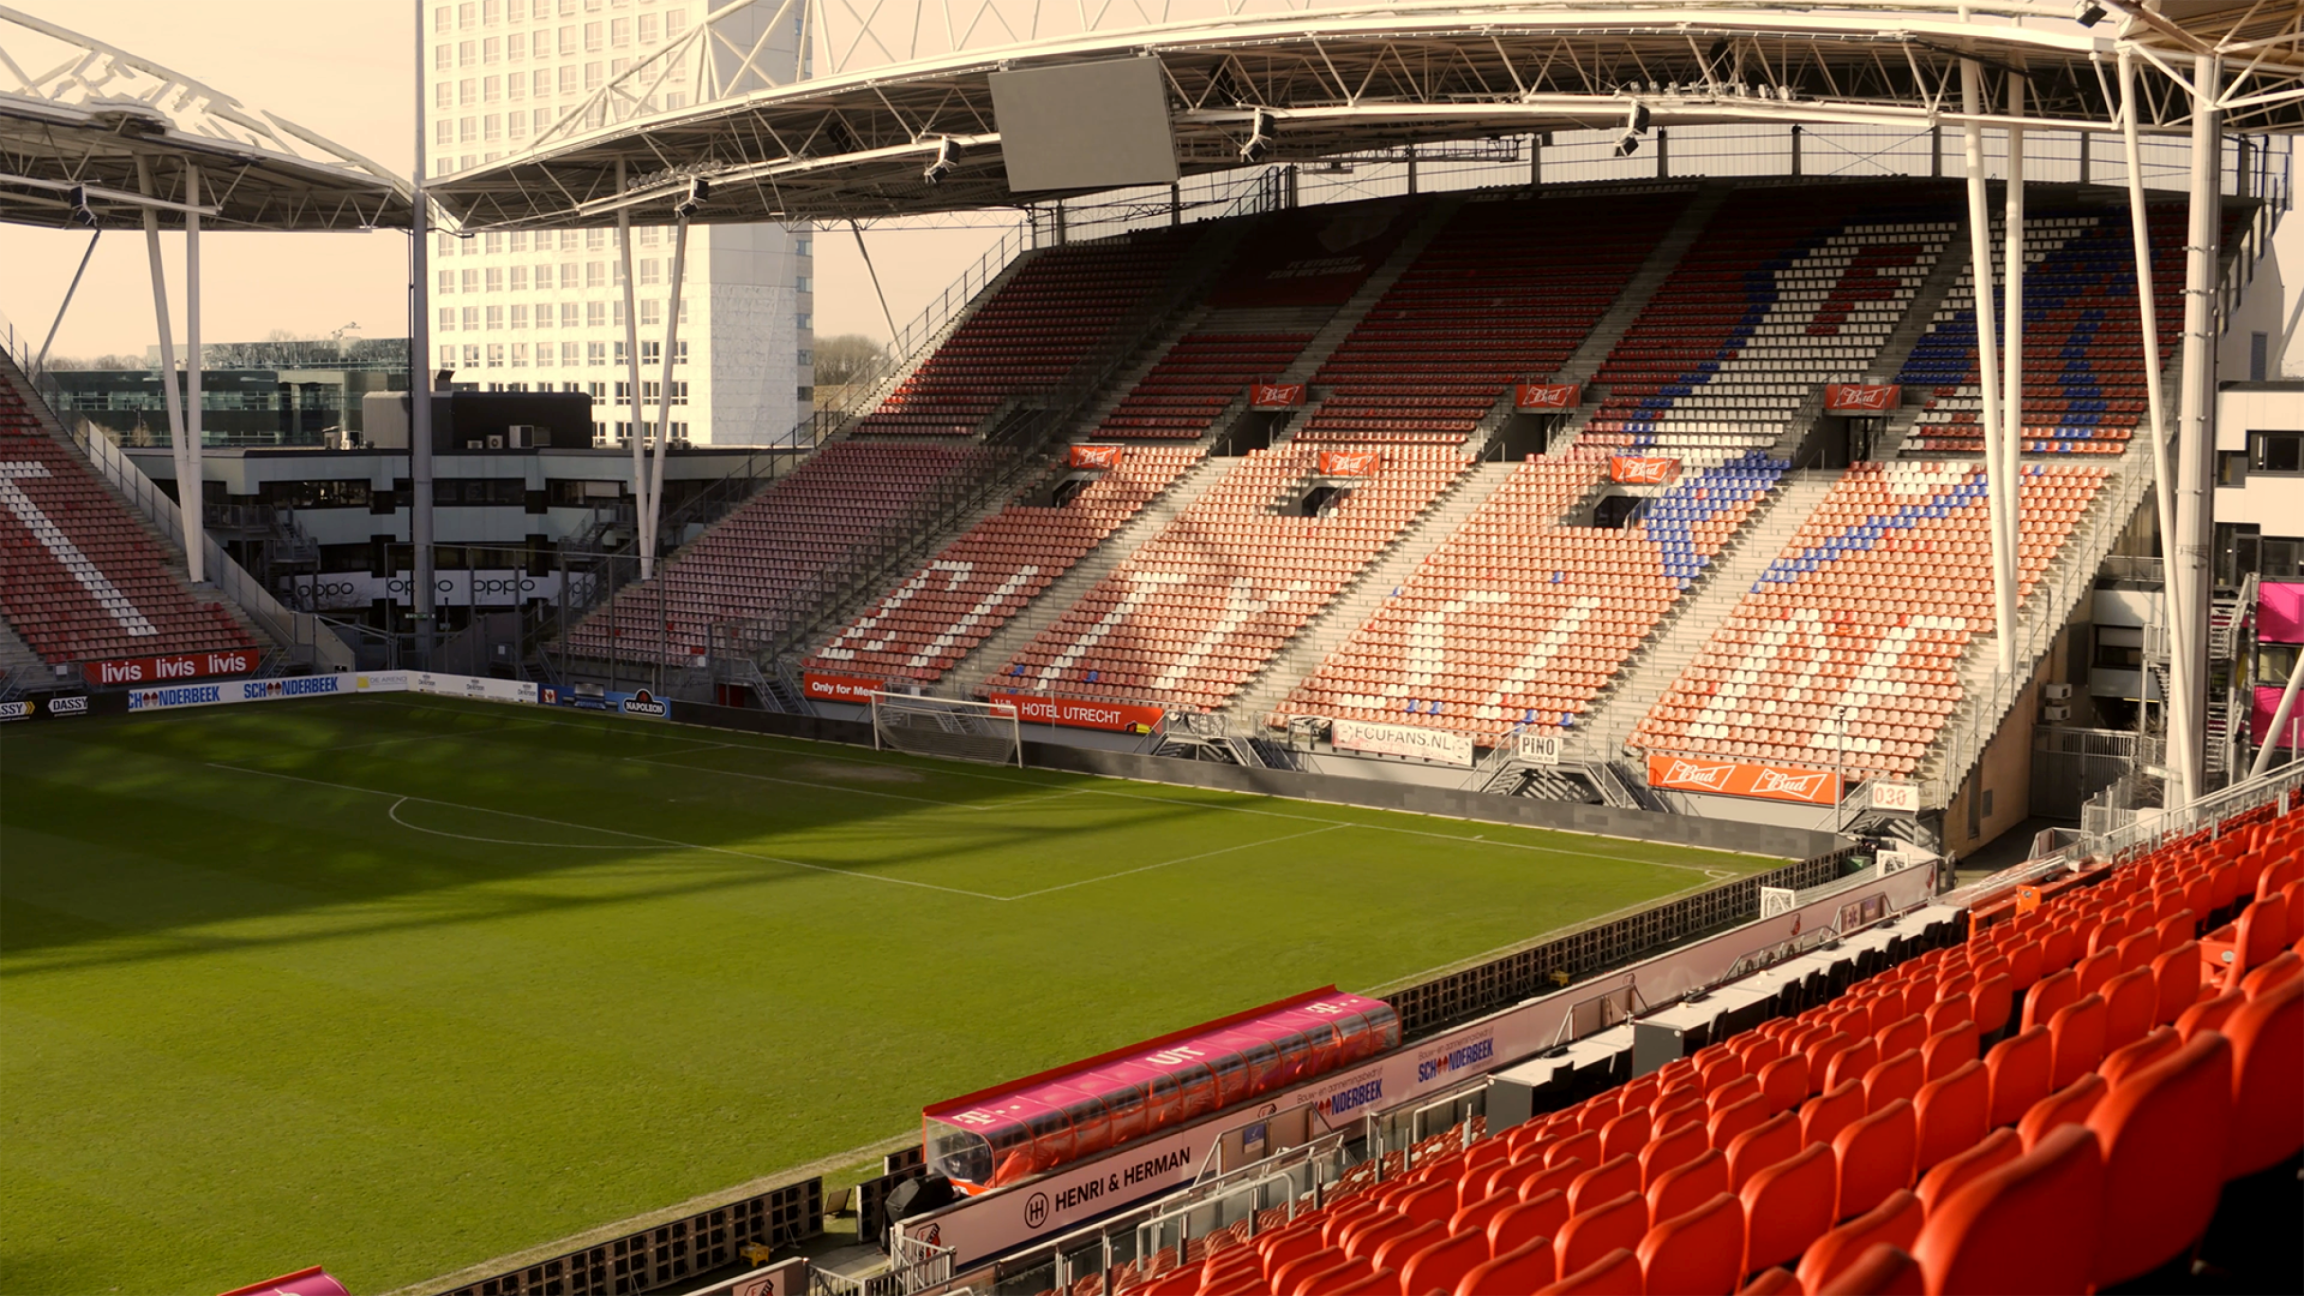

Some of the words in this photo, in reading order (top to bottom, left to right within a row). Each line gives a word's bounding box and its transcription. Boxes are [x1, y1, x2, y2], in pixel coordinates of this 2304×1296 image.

[298, 582, 354, 599] oppo
[388, 580, 453, 596] opo
[472, 579, 535, 595] oppo
[102, 662, 142, 683] livis
[155, 657, 195, 678] livis
[208, 652, 247, 673] livis
[812, 681, 834, 695] Only
[836, 684, 852, 694] for
[0, 703, 23, 715] SSY
[53, 698, 87, 711] DASSY
[625, 702, 664, 713] NAPOLEON
[1021, 702, 1060, 718] HOTEL
[1063, 706, 1121, 724] UTRECHT
[1355, 725, 1452, 751] FCUFANS.NL
[1522, 737, 1554, 756] PINO
[1675, 761, 1717, 783] Bud
[1764, 769, 1807, 791] Bud
[1875, 787, 1907, 806] 030
[1145, 1046, 1206, 1065] UIT
[1055, 1178, 1104, 1212] HENRI
[1108, 1173, 1119, 1192] &
[1124, 1146, 1191, 1187] HERMAN
